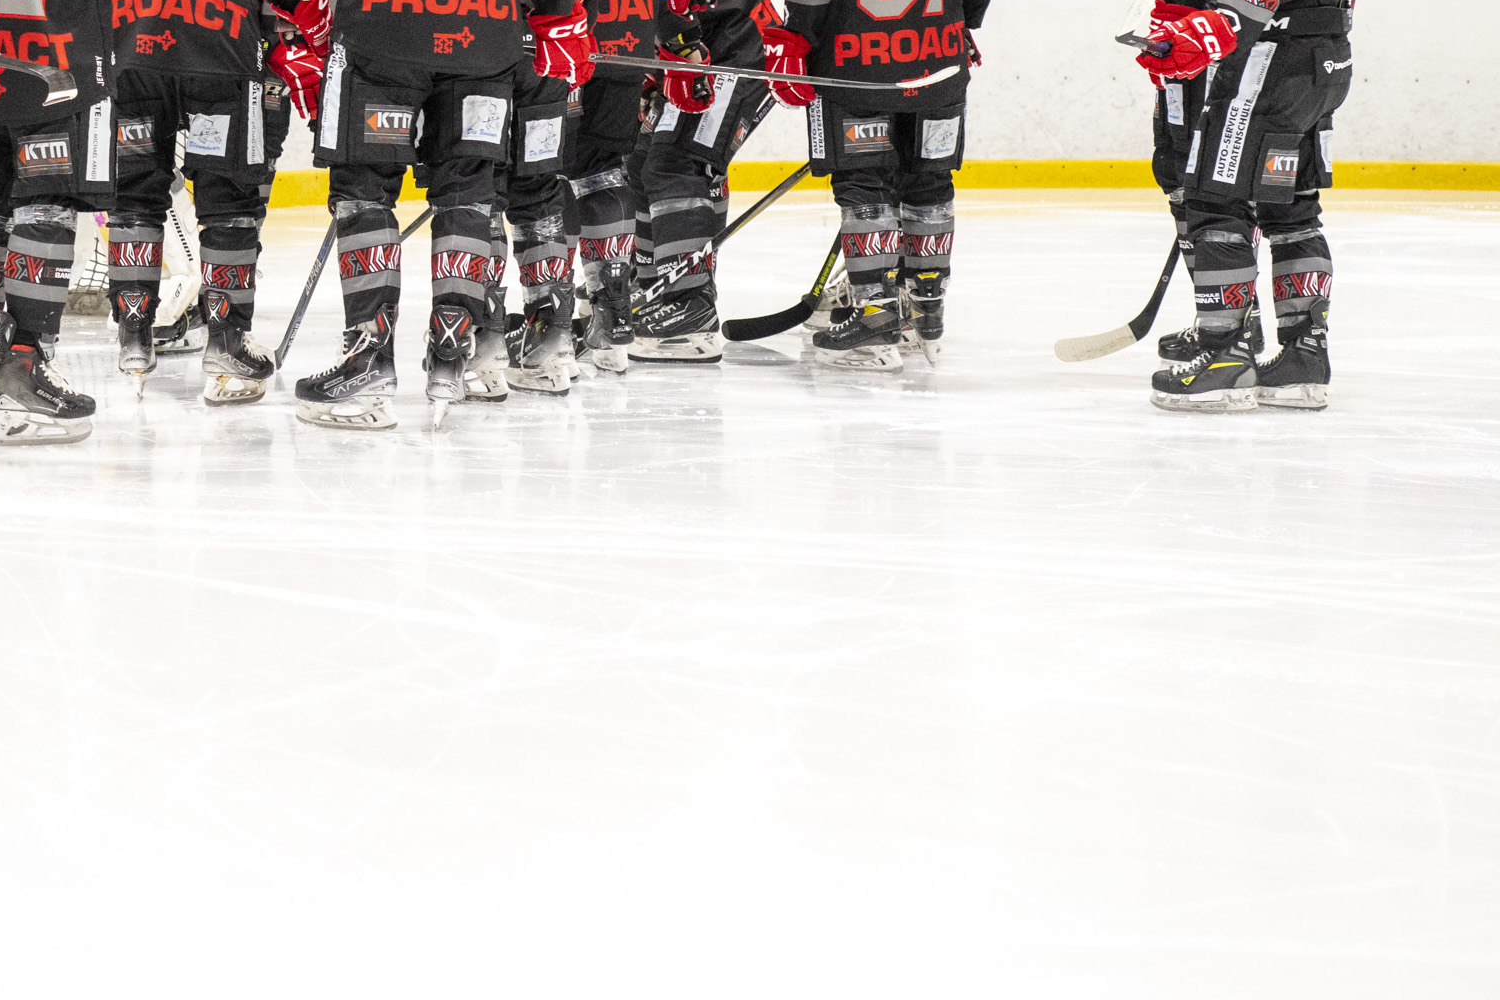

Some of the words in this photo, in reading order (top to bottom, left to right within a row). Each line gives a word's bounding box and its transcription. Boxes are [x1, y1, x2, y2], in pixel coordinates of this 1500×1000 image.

[548, 18, 587, 40] CC
[834, 20, 965, 67] PROACT
[24, 141, 68, 162] KTM
[1217, 105, 1239, 177] AUTO-SERVICE
[1227, 98, 1253, 179] STRATENSCHULTE
[644, 240, 713, 303] CCM
[325, 369, 386, 398] VAPOR
